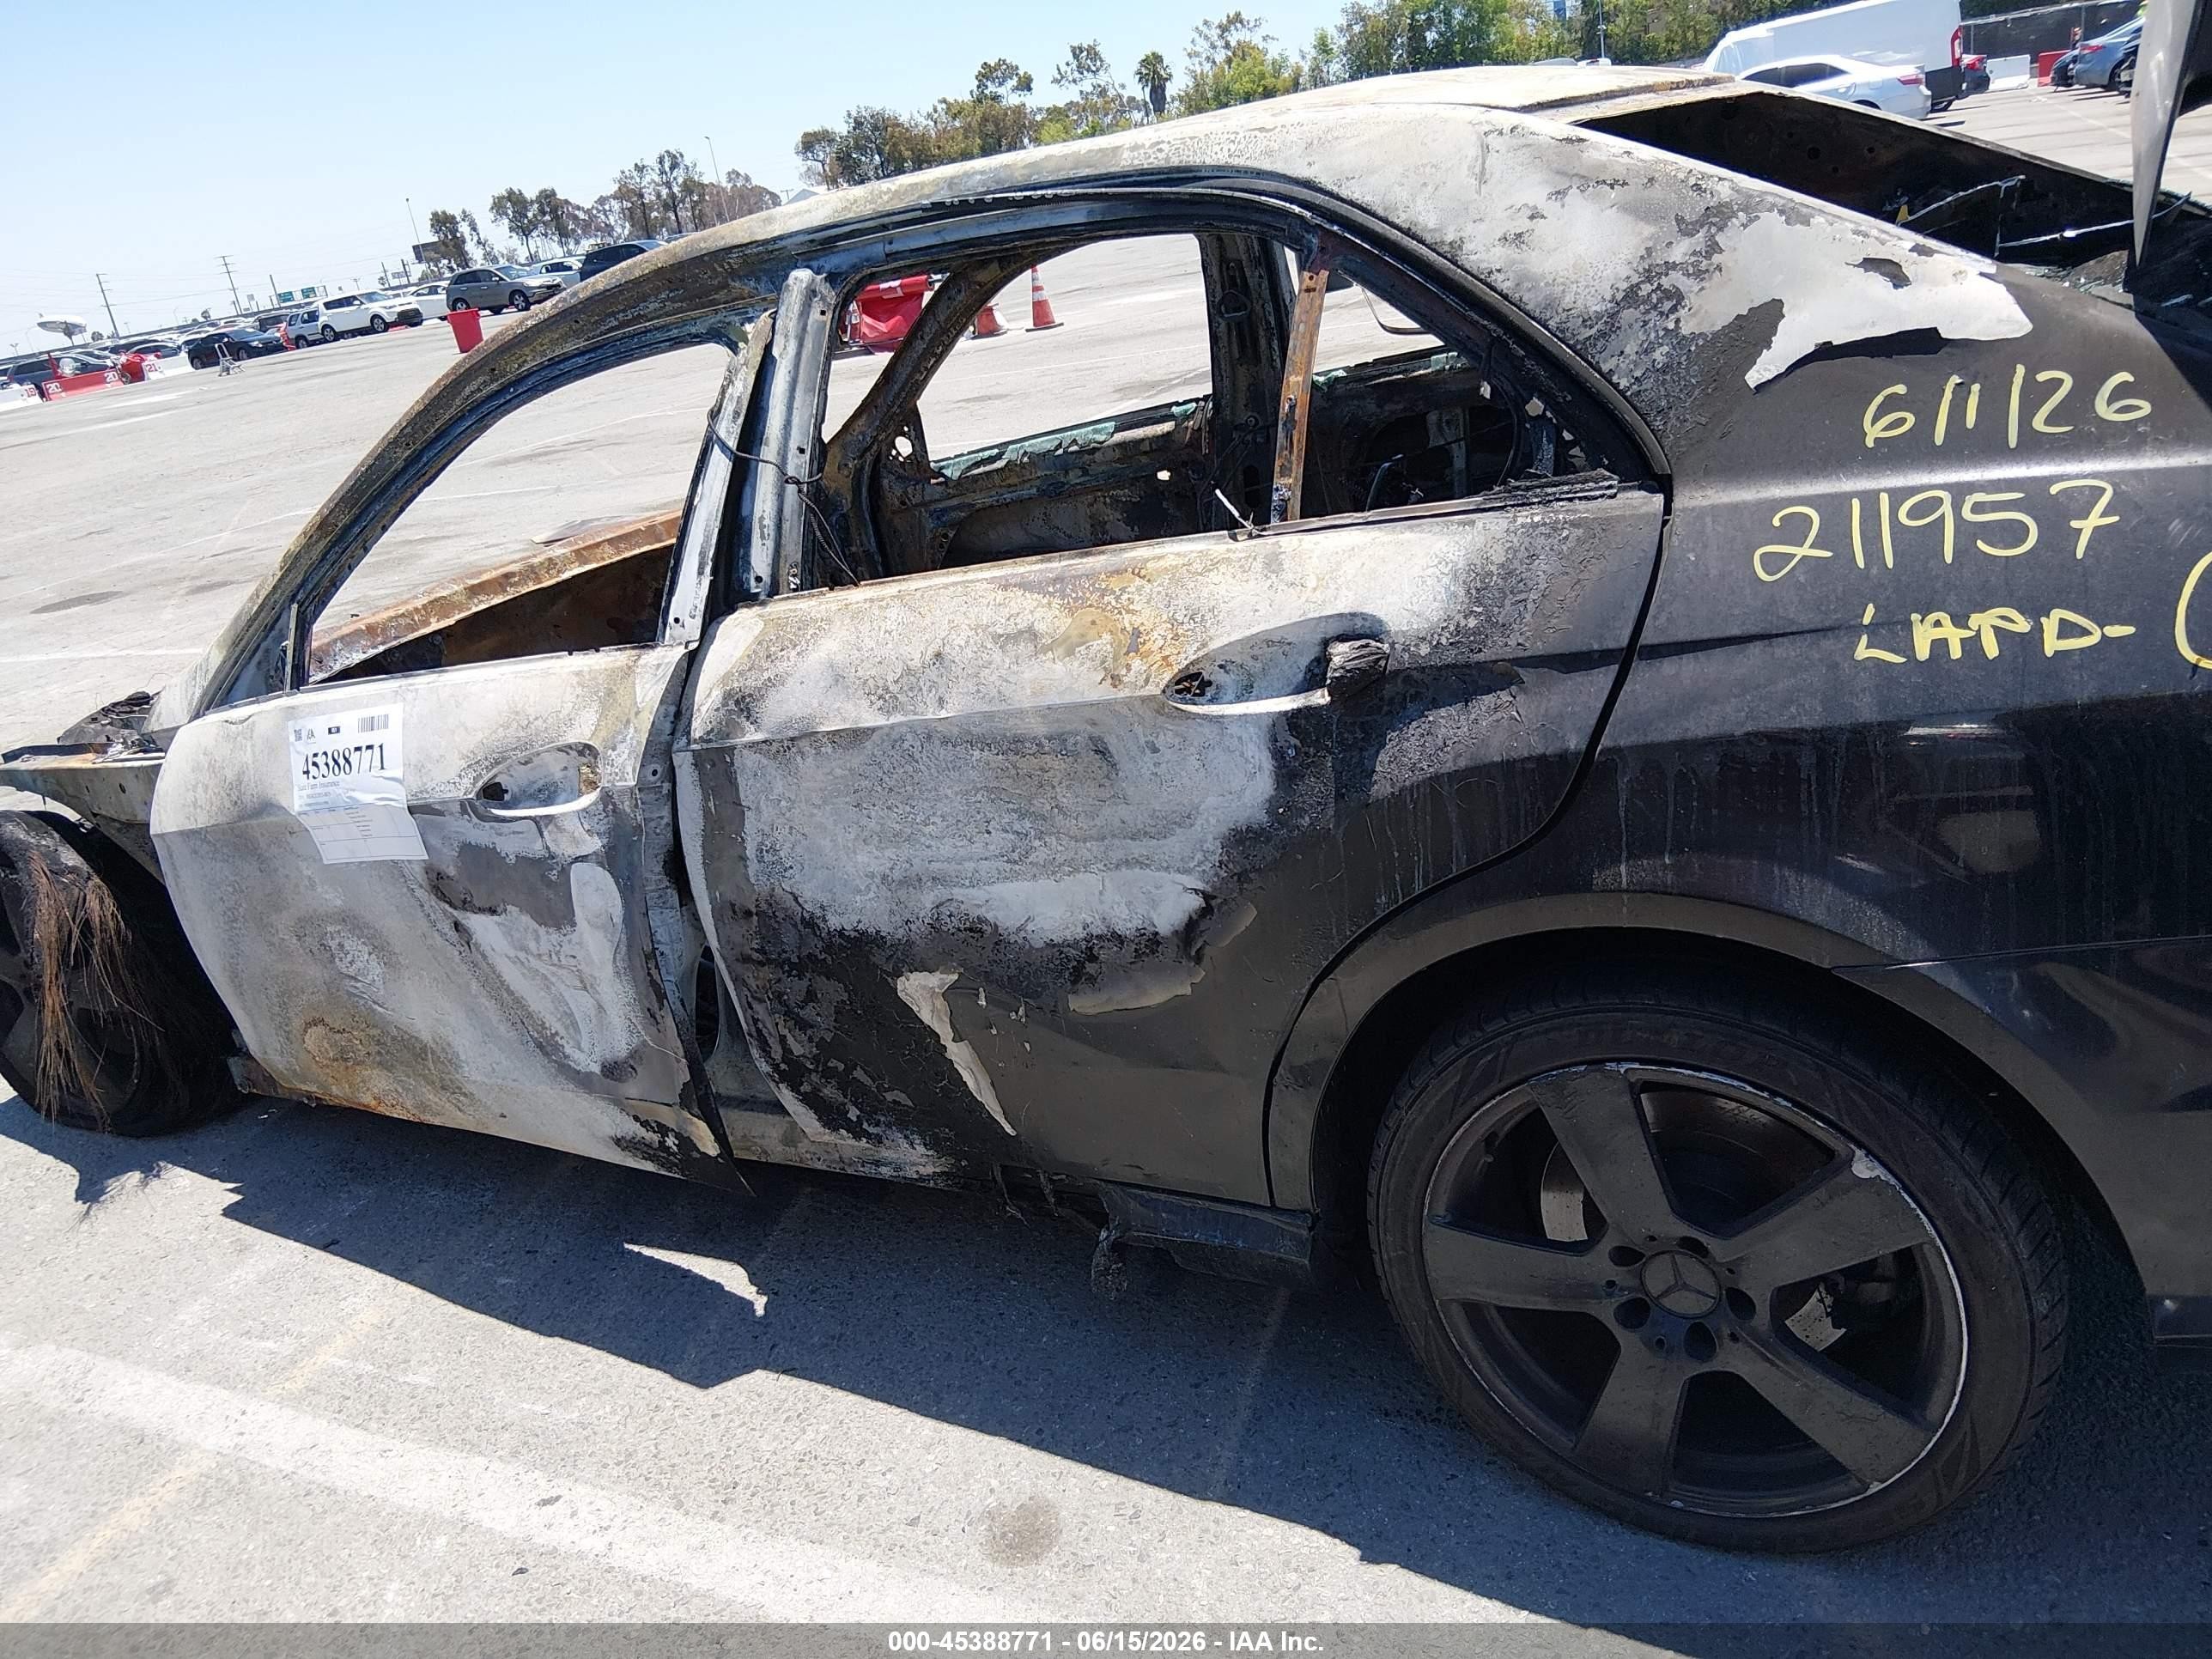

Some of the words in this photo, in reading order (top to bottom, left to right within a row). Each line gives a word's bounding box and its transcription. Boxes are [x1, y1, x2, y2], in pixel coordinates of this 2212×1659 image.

[104, 371, 118, 382] 20
[145, 363, 158, 373] 21
[46, 382, 62, 393] 20
[1863, 364, 2152, 448] 6/1/26
[1753, 479, 2120, 581] 211957
[302, 742, 387, 781] 45388771
